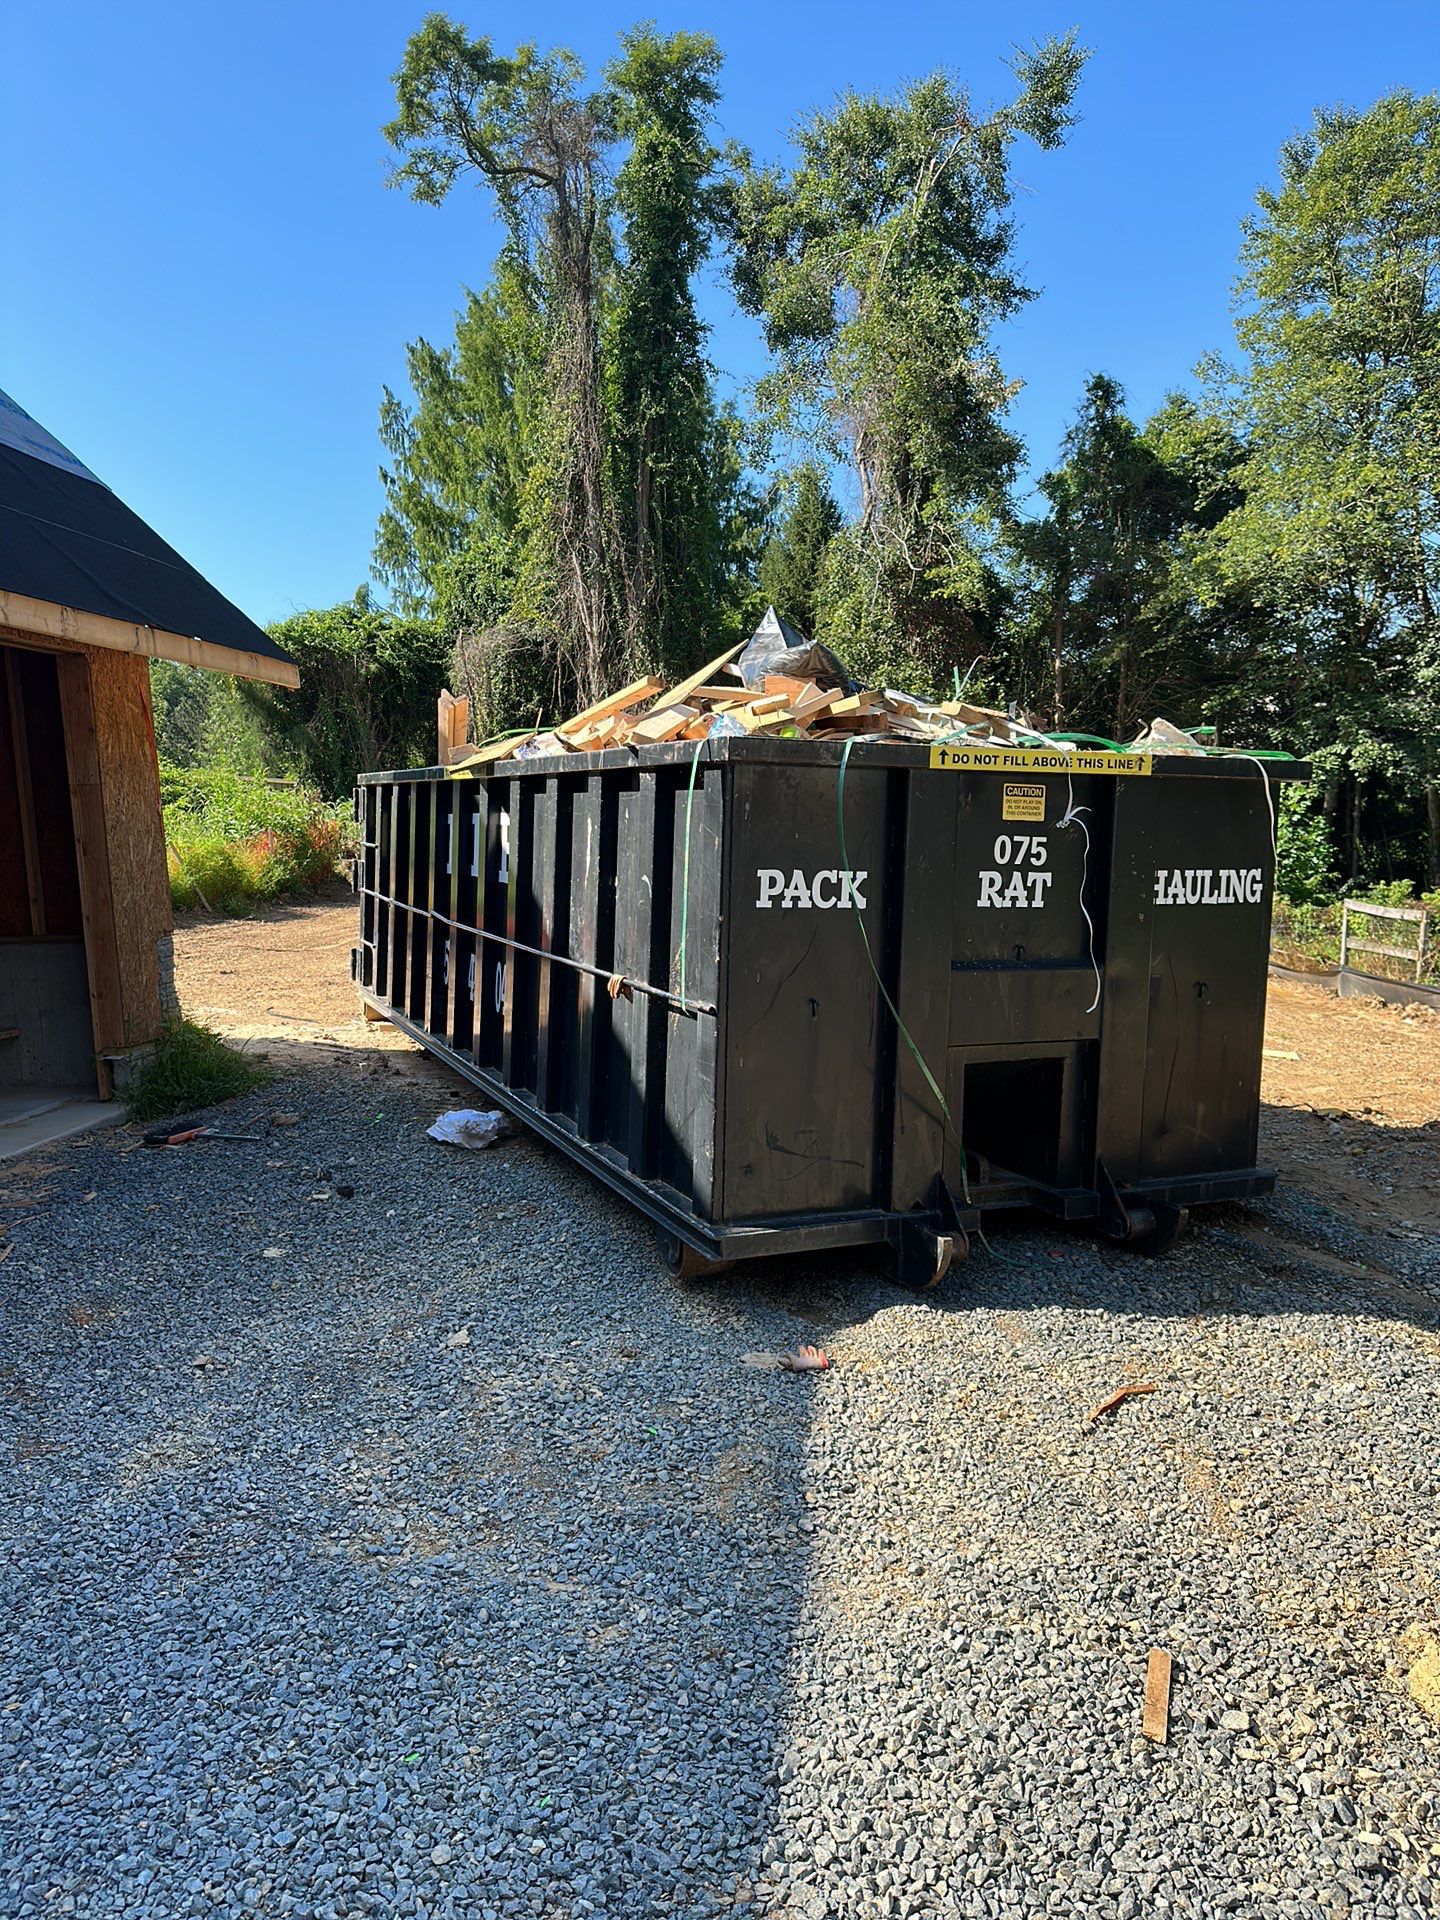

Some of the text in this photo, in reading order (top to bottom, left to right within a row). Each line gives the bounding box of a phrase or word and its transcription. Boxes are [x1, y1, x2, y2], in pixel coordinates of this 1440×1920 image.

[952, 754, 1133, 770] DO NOT FILL ABOVE THIS LINE
[1007, 787, 1042, 796] CAUTION
[994, 835, 1047, 866] 075
[756, 868, 1263, 909] PACK RAT HAULING
